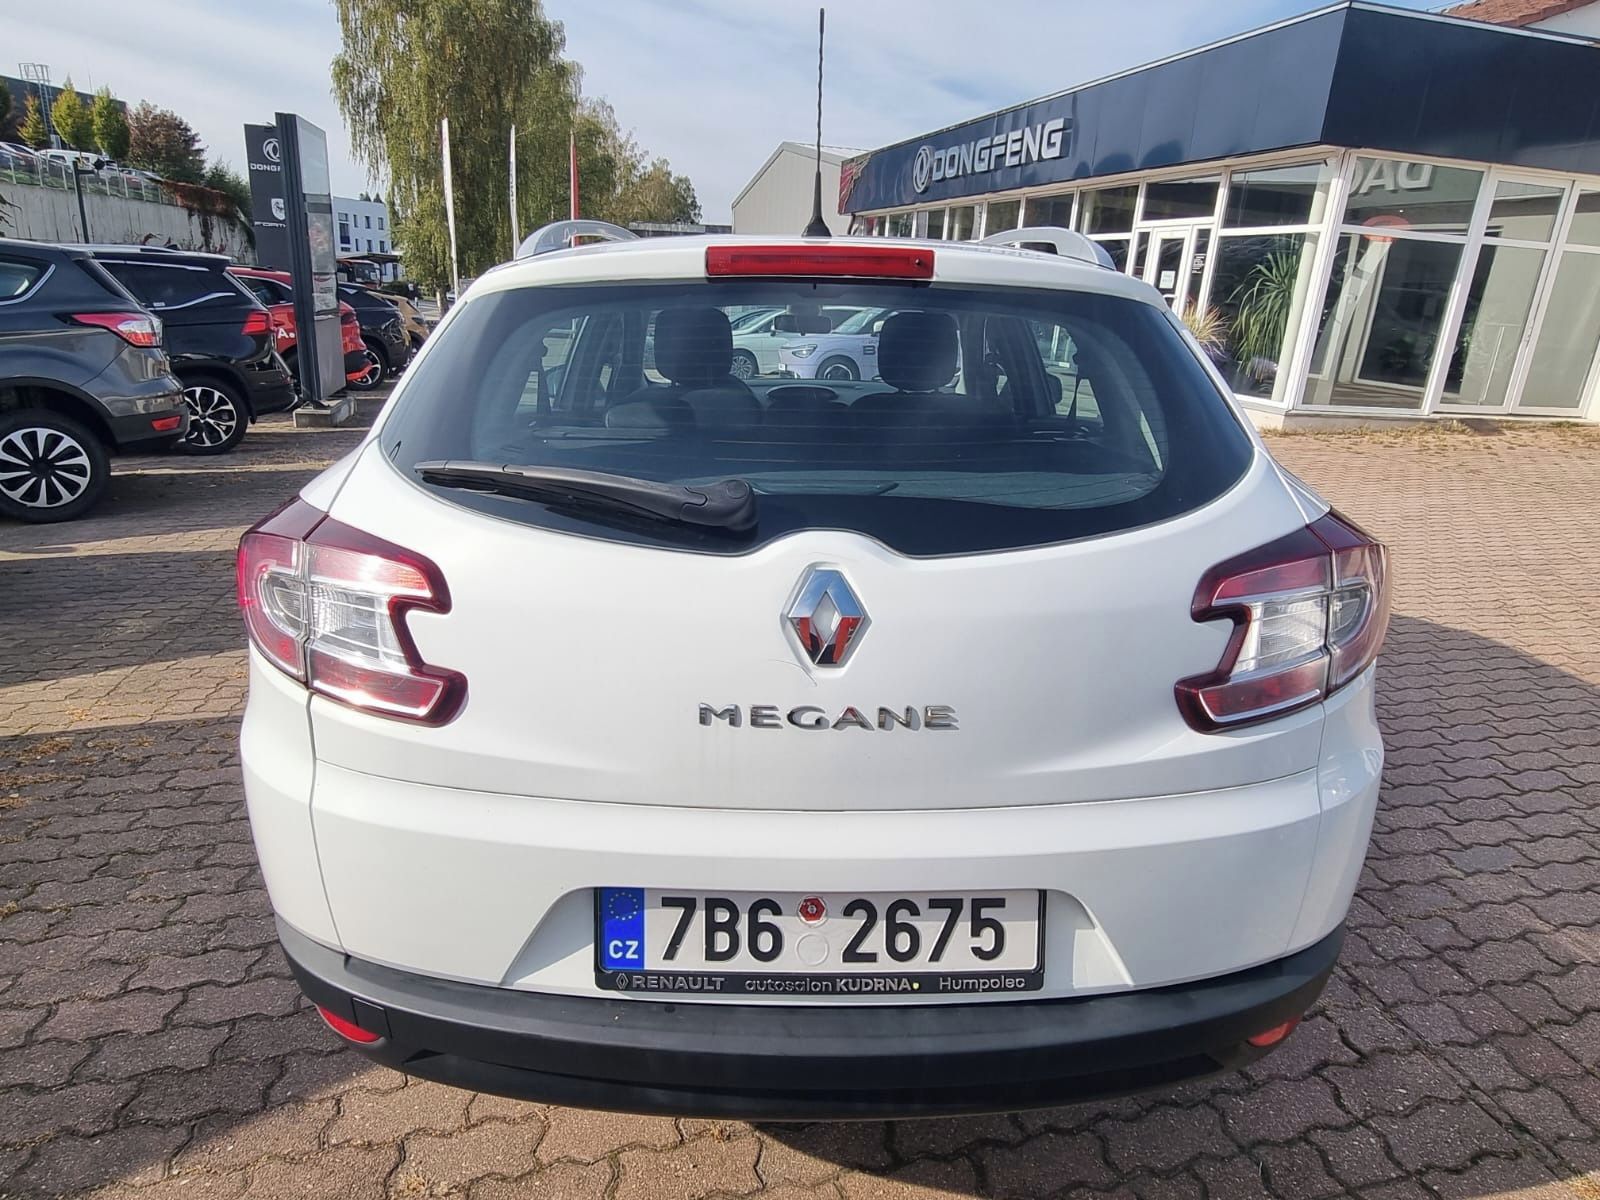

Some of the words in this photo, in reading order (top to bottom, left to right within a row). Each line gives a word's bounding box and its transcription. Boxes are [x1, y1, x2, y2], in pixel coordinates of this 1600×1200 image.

[932, 118, 1066, 181] DONGFENG
[698, 702, 960, 731] MEGANE
[660, 896, 784, 963] 7B6
[841, 896, 1007, 963] 2675
[608, 939, 639, 960] CZ
[632, 975, 725, 990] RENAULT
[745, 978, 832, 992] autosalon
[939, 976, 1026, 992] Humpolec
